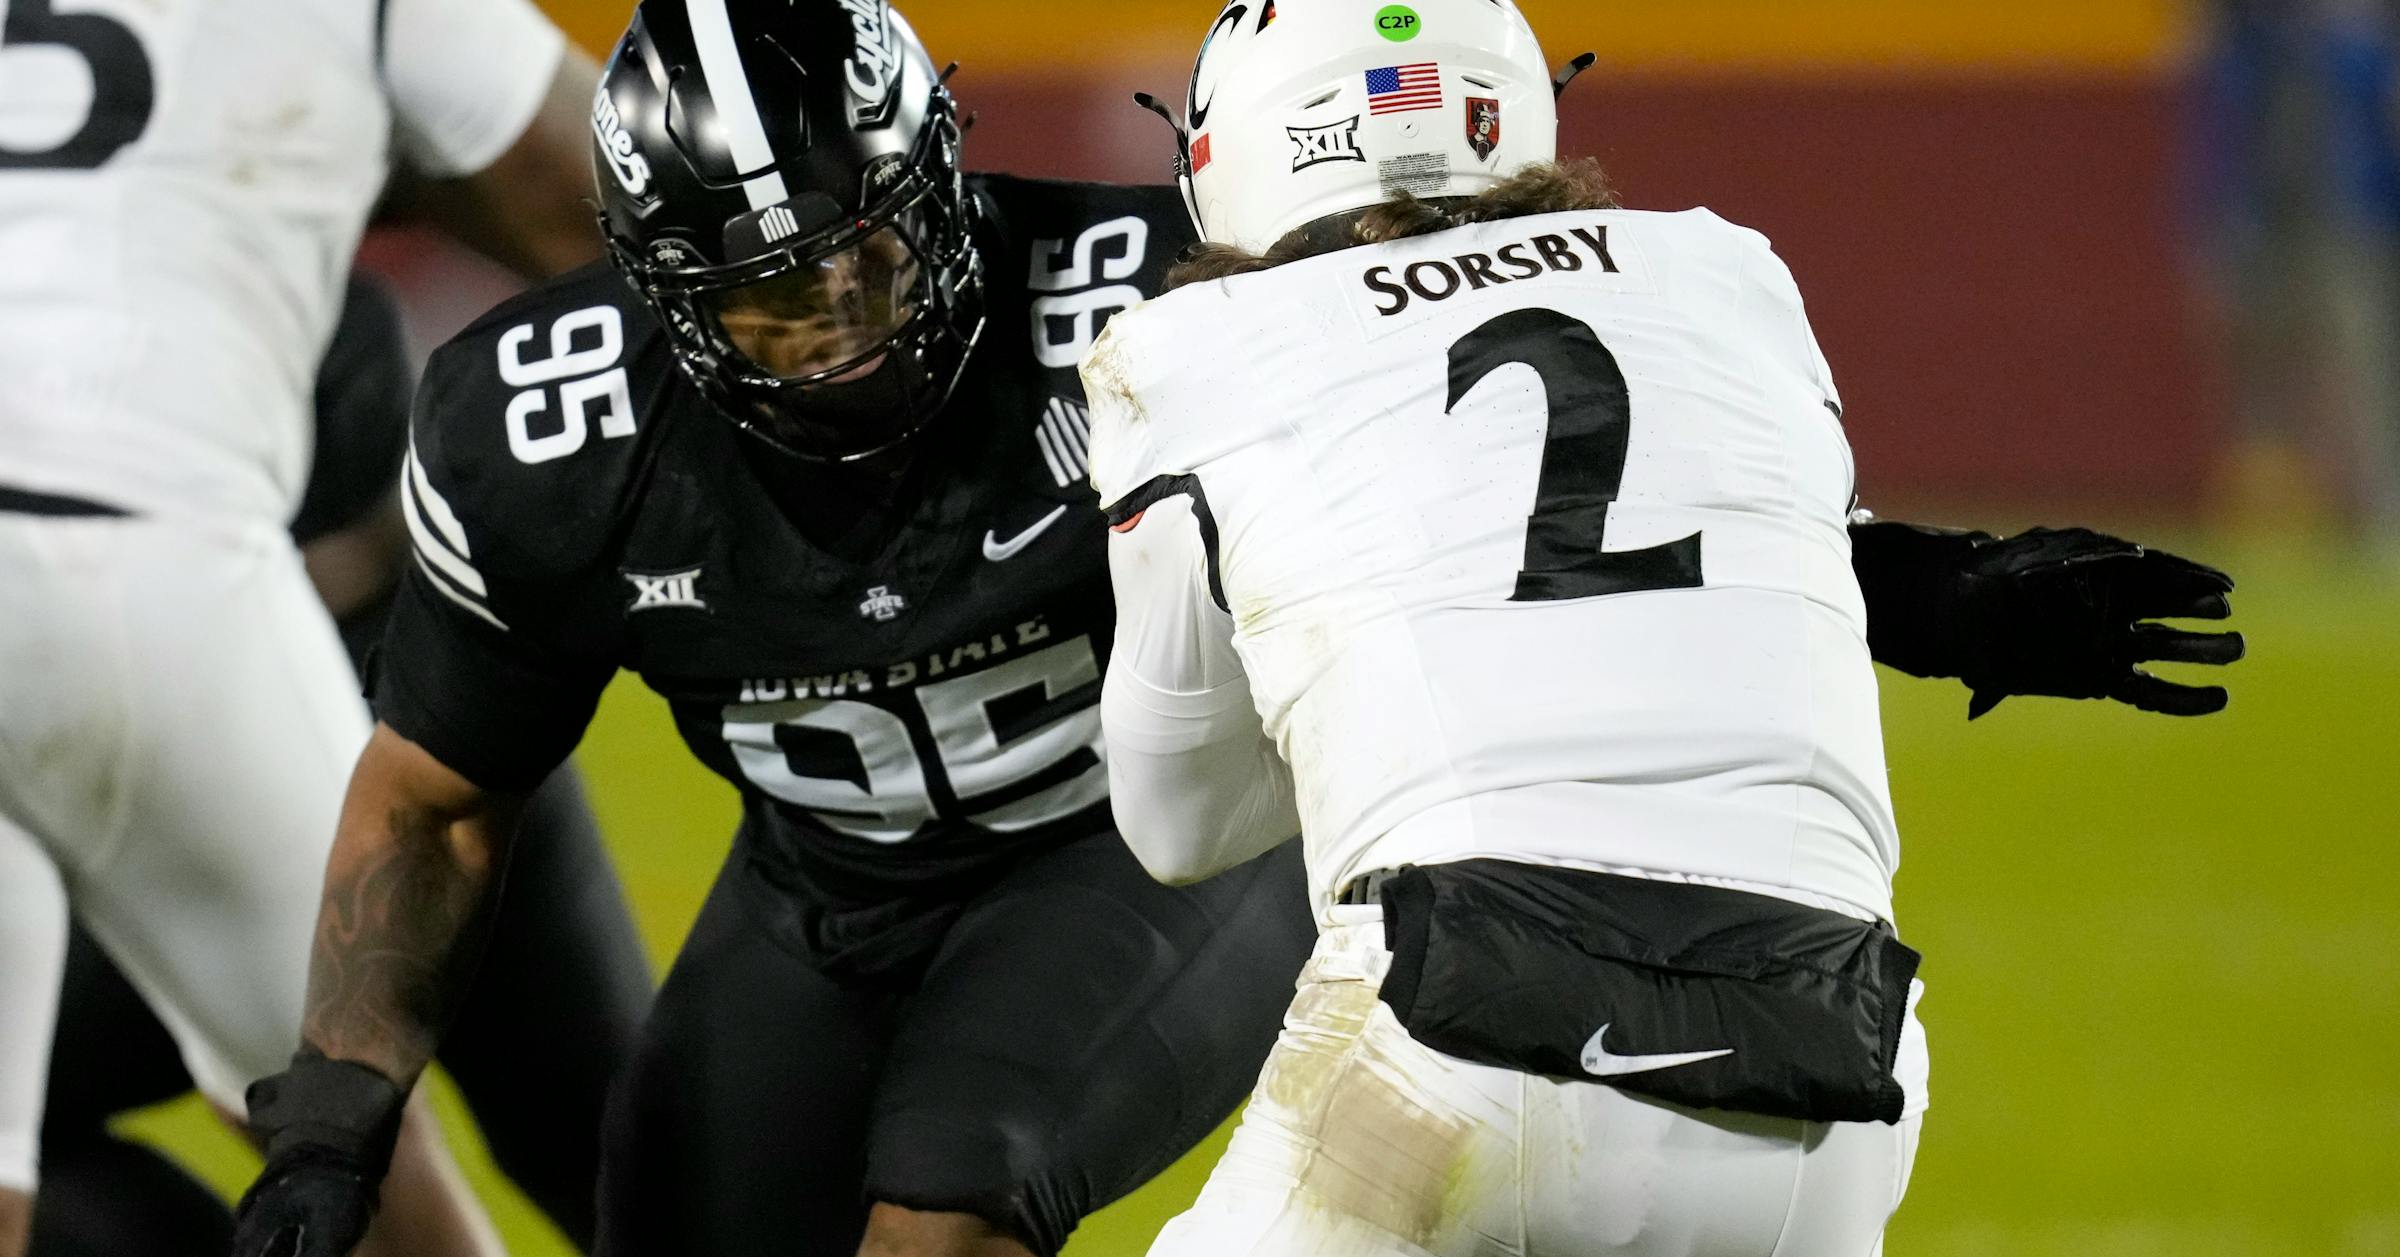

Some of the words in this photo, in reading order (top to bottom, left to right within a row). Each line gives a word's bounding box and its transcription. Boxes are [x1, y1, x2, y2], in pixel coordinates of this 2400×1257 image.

[1378, 15, 1416, 29] C2P
[1285, 113, 1367, 174] XII
[1027, 215, 1148, 369] 95
[1364, 225, 1621, 317] SORSBY
[497, 304, 638, 465] 95
[1444, 307, 1704, 602] 2
[624, 568, 706, 612] XII
[721, 633, 1109, 844] 95
